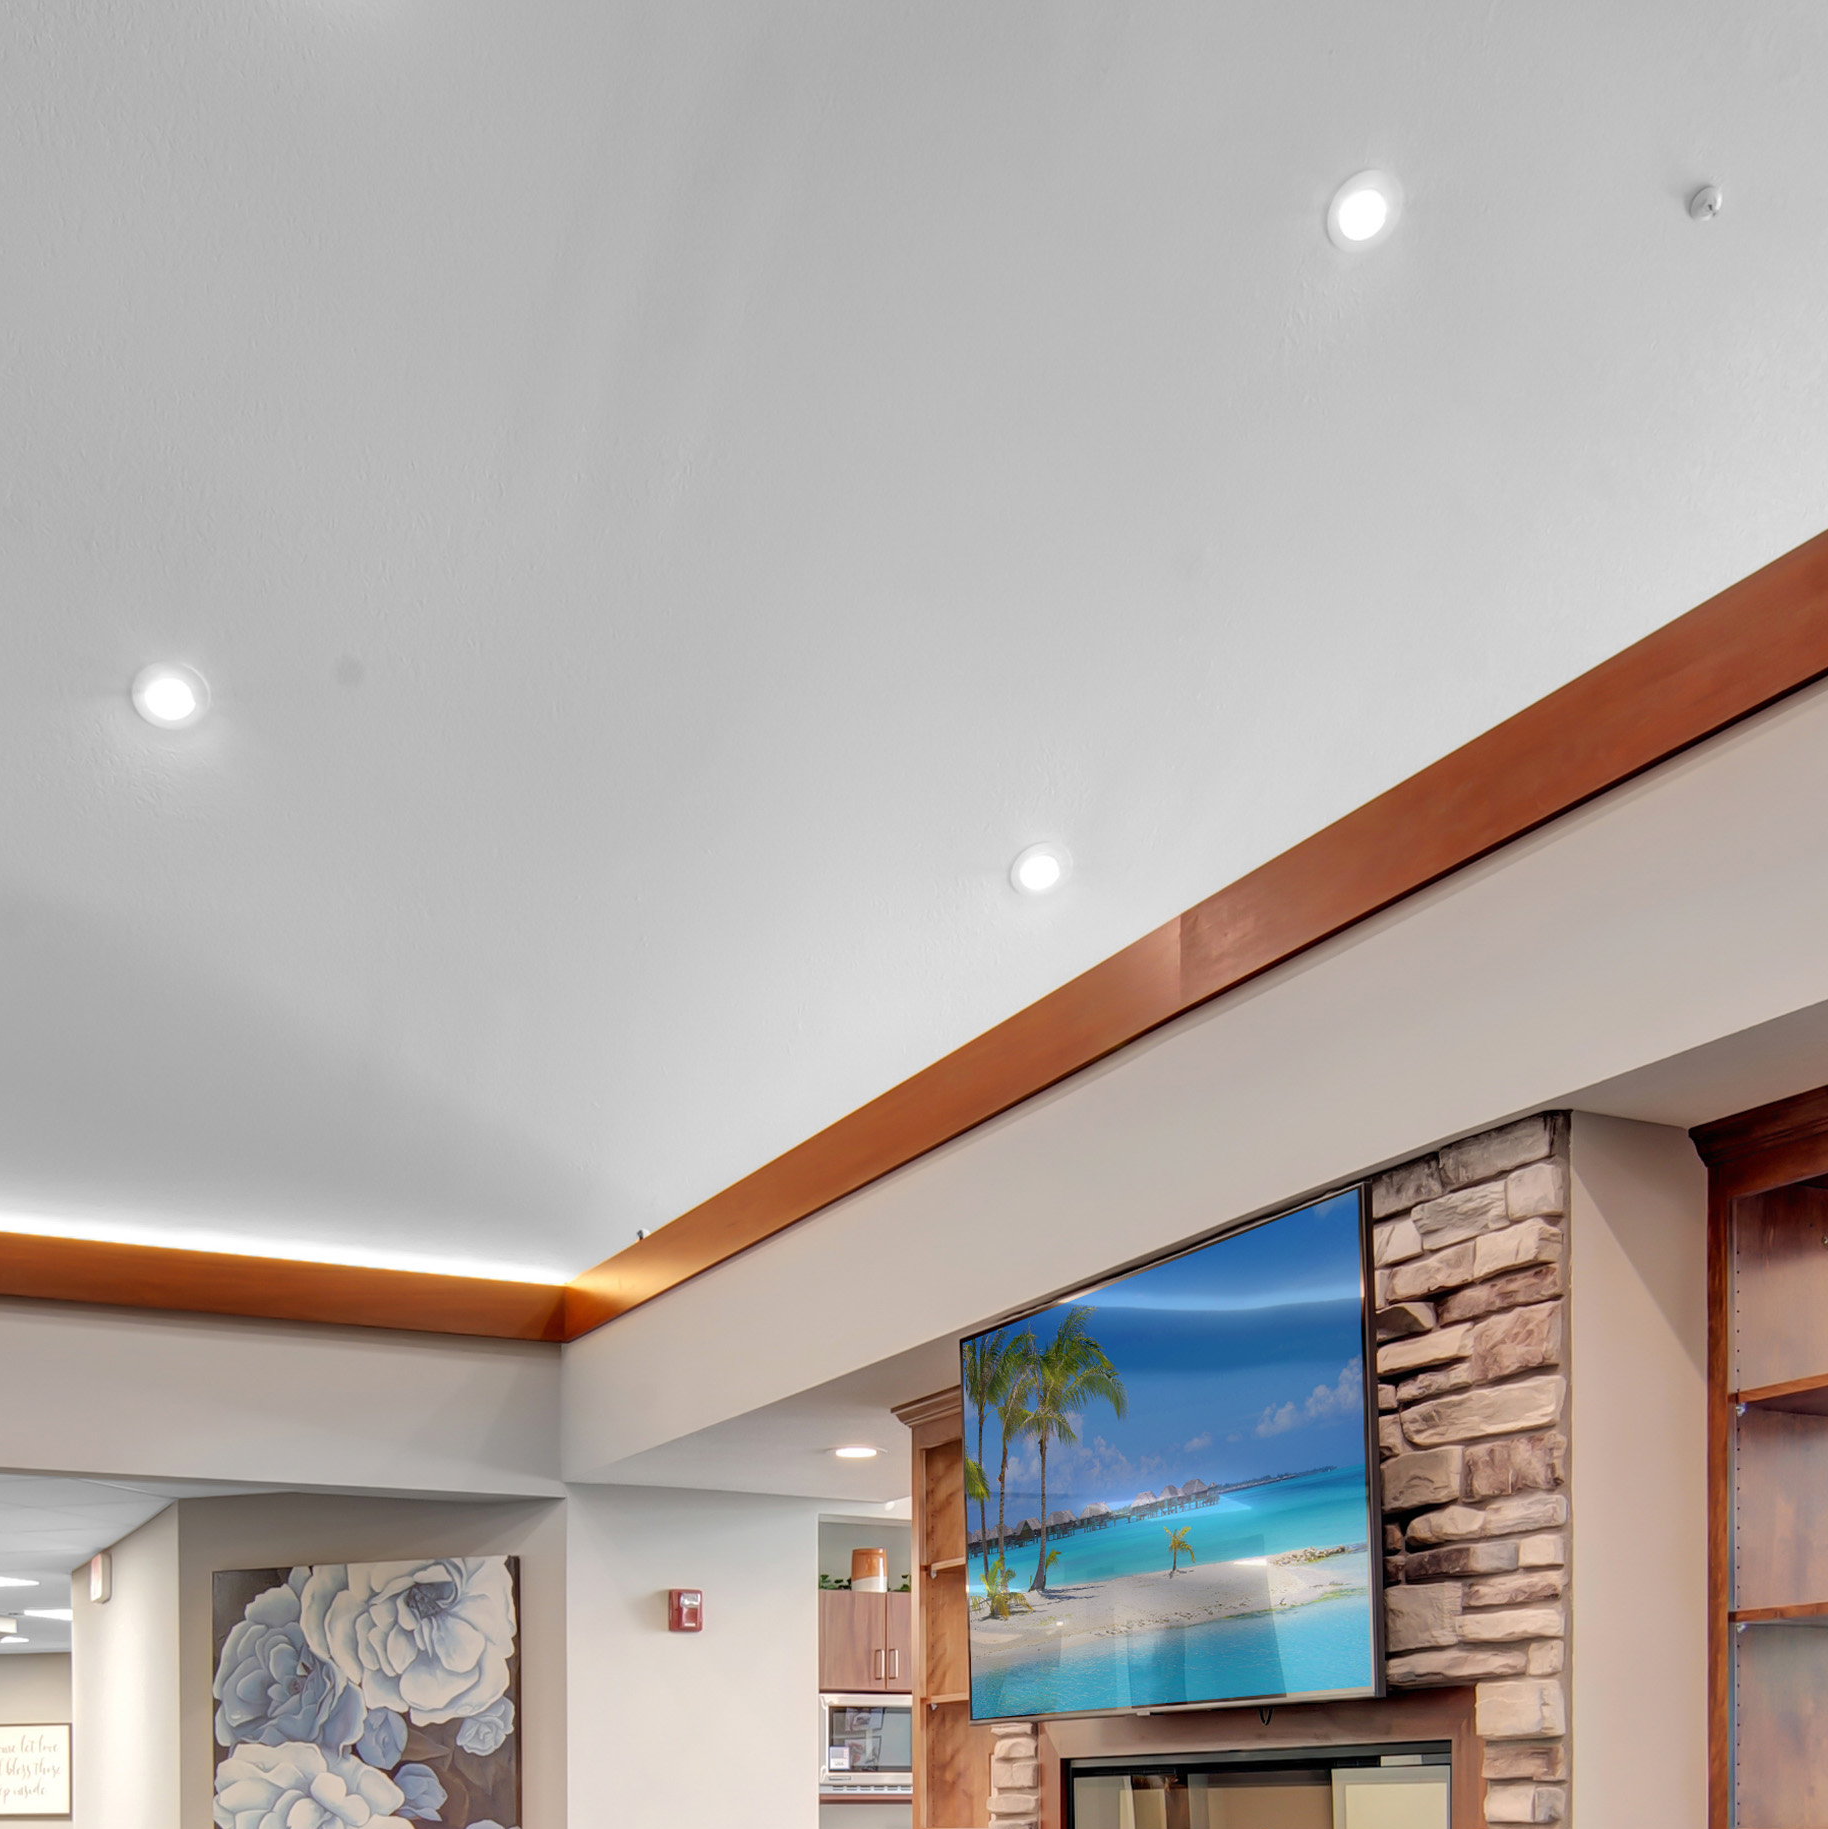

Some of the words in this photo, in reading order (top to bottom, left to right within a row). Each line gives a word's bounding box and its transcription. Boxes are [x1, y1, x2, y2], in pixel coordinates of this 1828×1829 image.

[20, 1734, 34, 1753] let
[38, 1734, 58, 1753] love
[6, 1757, 32, 1780] bless
[33, 1757, 60, 1778] those
[13, 1777, 45, 1799] inside
